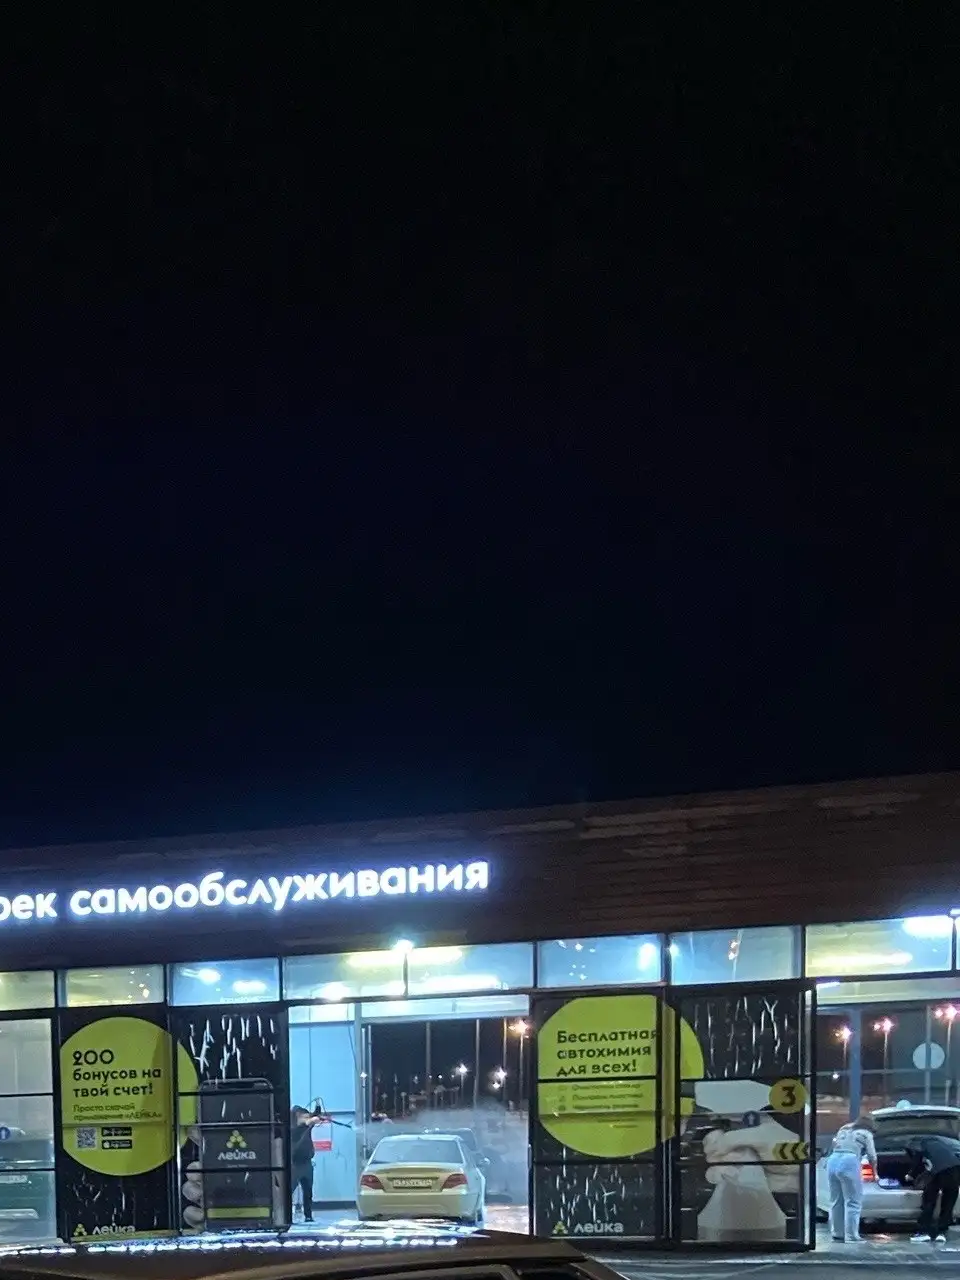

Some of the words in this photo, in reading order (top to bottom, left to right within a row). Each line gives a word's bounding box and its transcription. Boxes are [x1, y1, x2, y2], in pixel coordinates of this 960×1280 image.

[69, 861, 490, 916] самообслуживания
[557, 1030, 657, 1043] Бесплатная
[73, 1049, 114, 1066] 200
[557, 1046, 651, 1059] автохимия
[557, 1065, 587, 1077] для
[591, 1059, 637, 1074] всех!
[73, 1069, 137, 1082] бонусов
[142, 1069, 161, 1079] на
[73, 1083, 109, 1098] твой
[113, 1083, 153, 1096] счет!
[781, 1086, 796, 1107] 3
[73, 1104, 104, 1113] Просто
[218, 1149, 256, 1160] лейка
[92, 1222, 136, 1235] лейка
[574, 1219, 624, 1233] лейка
